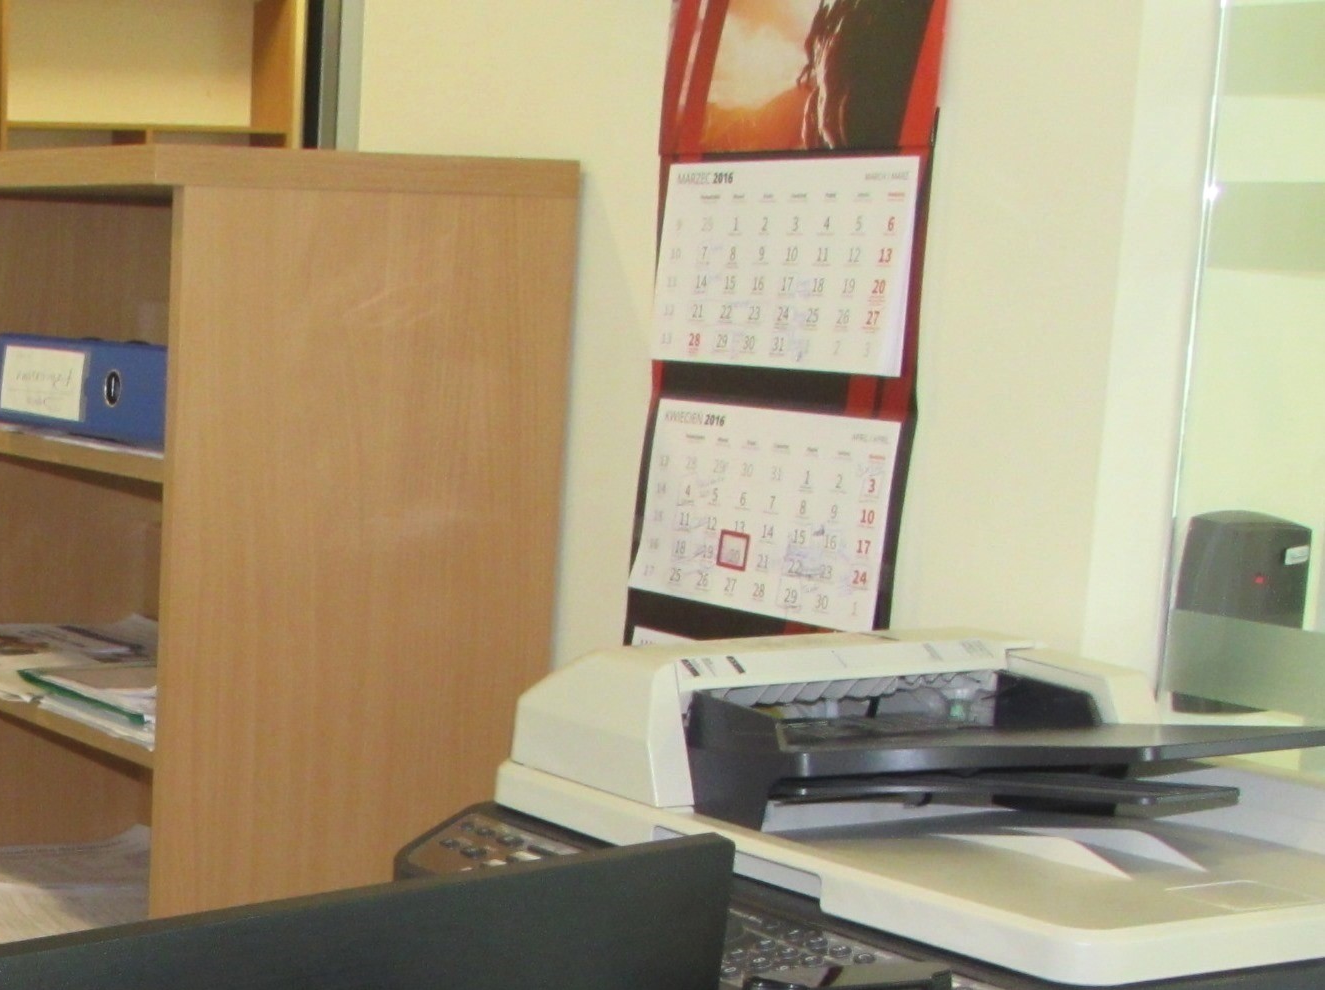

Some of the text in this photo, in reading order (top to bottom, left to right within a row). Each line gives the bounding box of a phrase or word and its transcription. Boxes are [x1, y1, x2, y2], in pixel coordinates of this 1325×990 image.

[712, 172, 734, 184] 2016
[888, 216, 895, 231] 6
[786, 246, 798, 262] 10
[817, 247, 828, 262] 11
[848, 247, 860, 263] 12
[878, 248, 892, 263] 13
[696, 275, 707, 289] 14
[725, 276, 736, 290] 15
[752, 276, 764, 291] 16
[781, 277, 794, 291] 17
[812, 278, 824, 292] 18
[842, 279, 855, 293] 19
[872, 279, 886, 294] 20
[692, 304, 703, 318] 21
[720, 305, 732, 319] 22
[748, 306, 760, 320] 23
[777, 306, 789, 321] 24
[806, 307, 819, 323] 25
[836, 309, 850, 324] 26
[866, 311, 880, 325] 27
[688, 333, 700, 346] 28
[716, 334, 728, 348] 29
[743, 335, 755, 350] 30
[772, 336, 784, 352] 31
[704, 414, 725, 427] 2016
[835, 474, 843, 489] 2
[868, 479, 875, 493] 3
[740, 492, 746, 506] 6
[799, 500, 806, 515] 8
[831, 504, 838, 519] 9
[860, 509, 875, 524] 10
[679, 511, 689, 526] 11
[707, 516, 717, 531] 12
[762, 525, 774, 539] 14
[793, 529, 805, 544] 15
[856, 540, 871, 555] 17
[757, 554, 769, 569] 21
[852, 570, 867, 585] 24
[669, 568, 681, 581] 25
[724, 577, 737, 592] 27
[753, 582, 765, 597] 28
[784, 588, 798, 603] 29
[816, 593, 828, 609] 30
